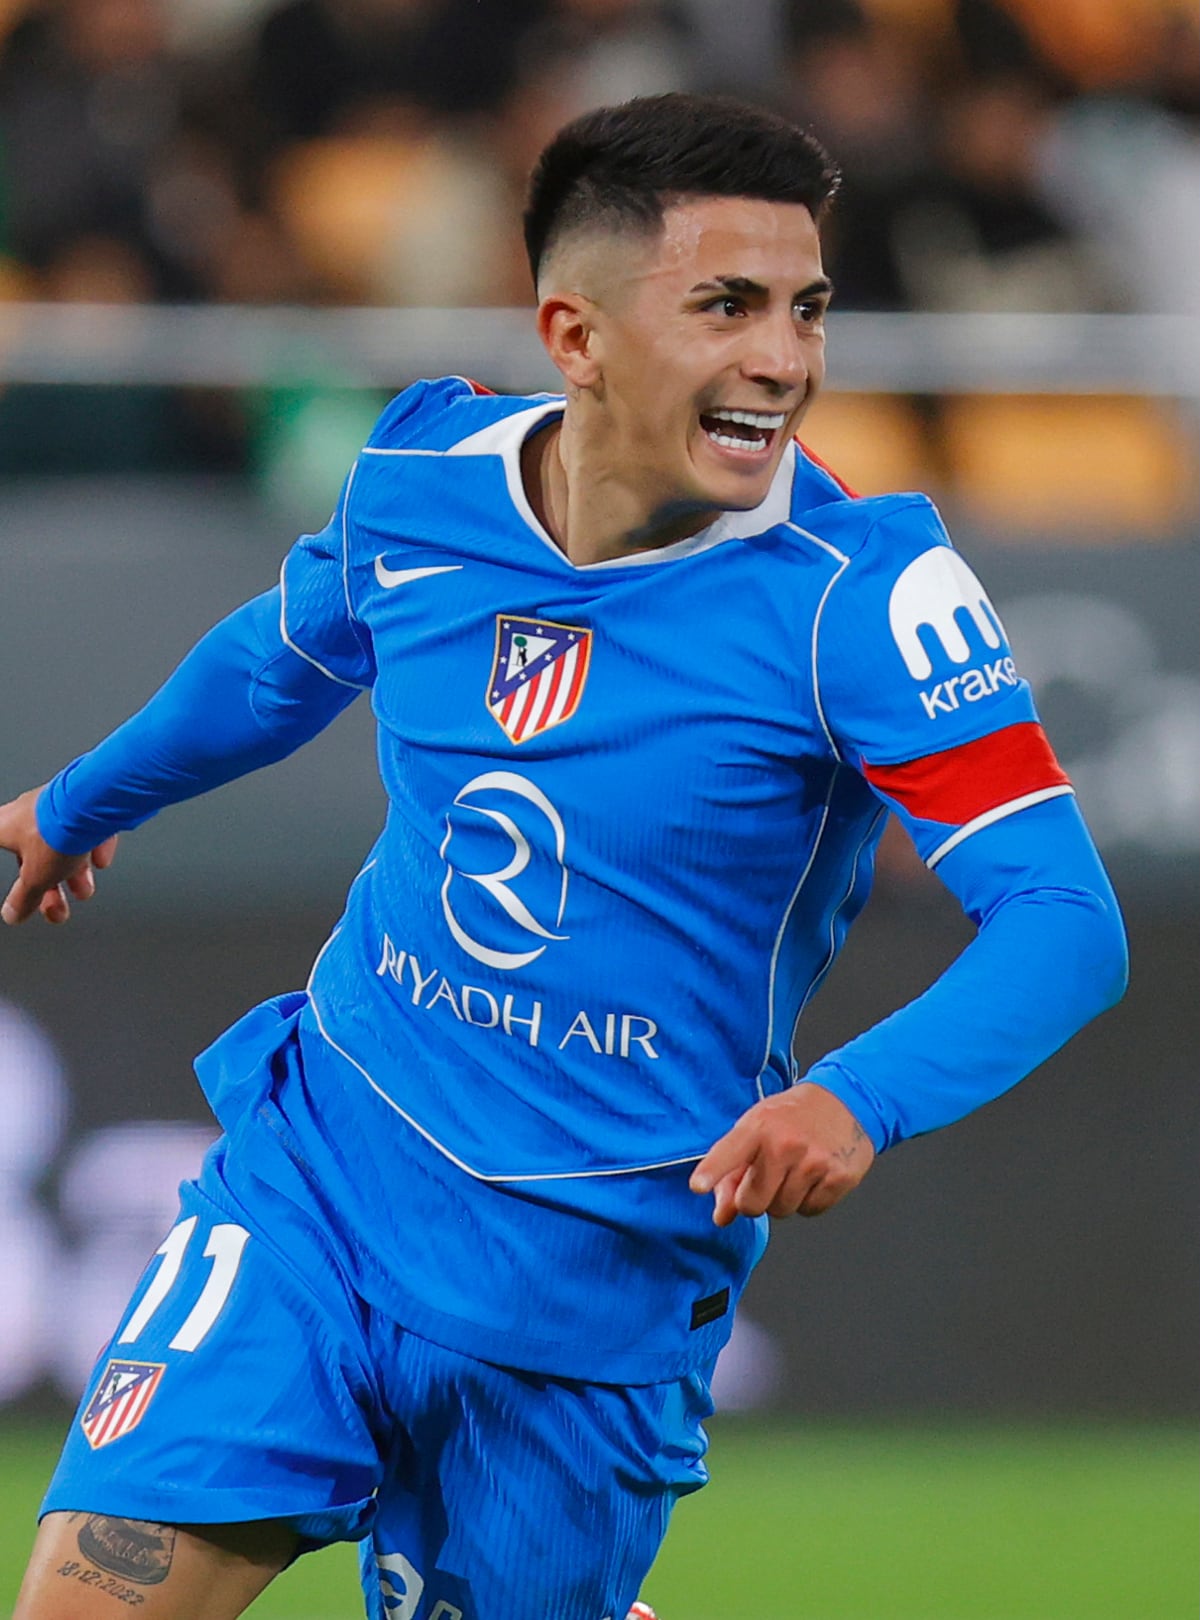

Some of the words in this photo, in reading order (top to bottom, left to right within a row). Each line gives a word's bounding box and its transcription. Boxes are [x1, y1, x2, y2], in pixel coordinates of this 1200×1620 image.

[919, 657, 1017, 720] krake
[376, 932, 542, 1047] RIYADH
[558, 1010, 659, 1059] AIR
[117, 1215, 251, 1353] 11
